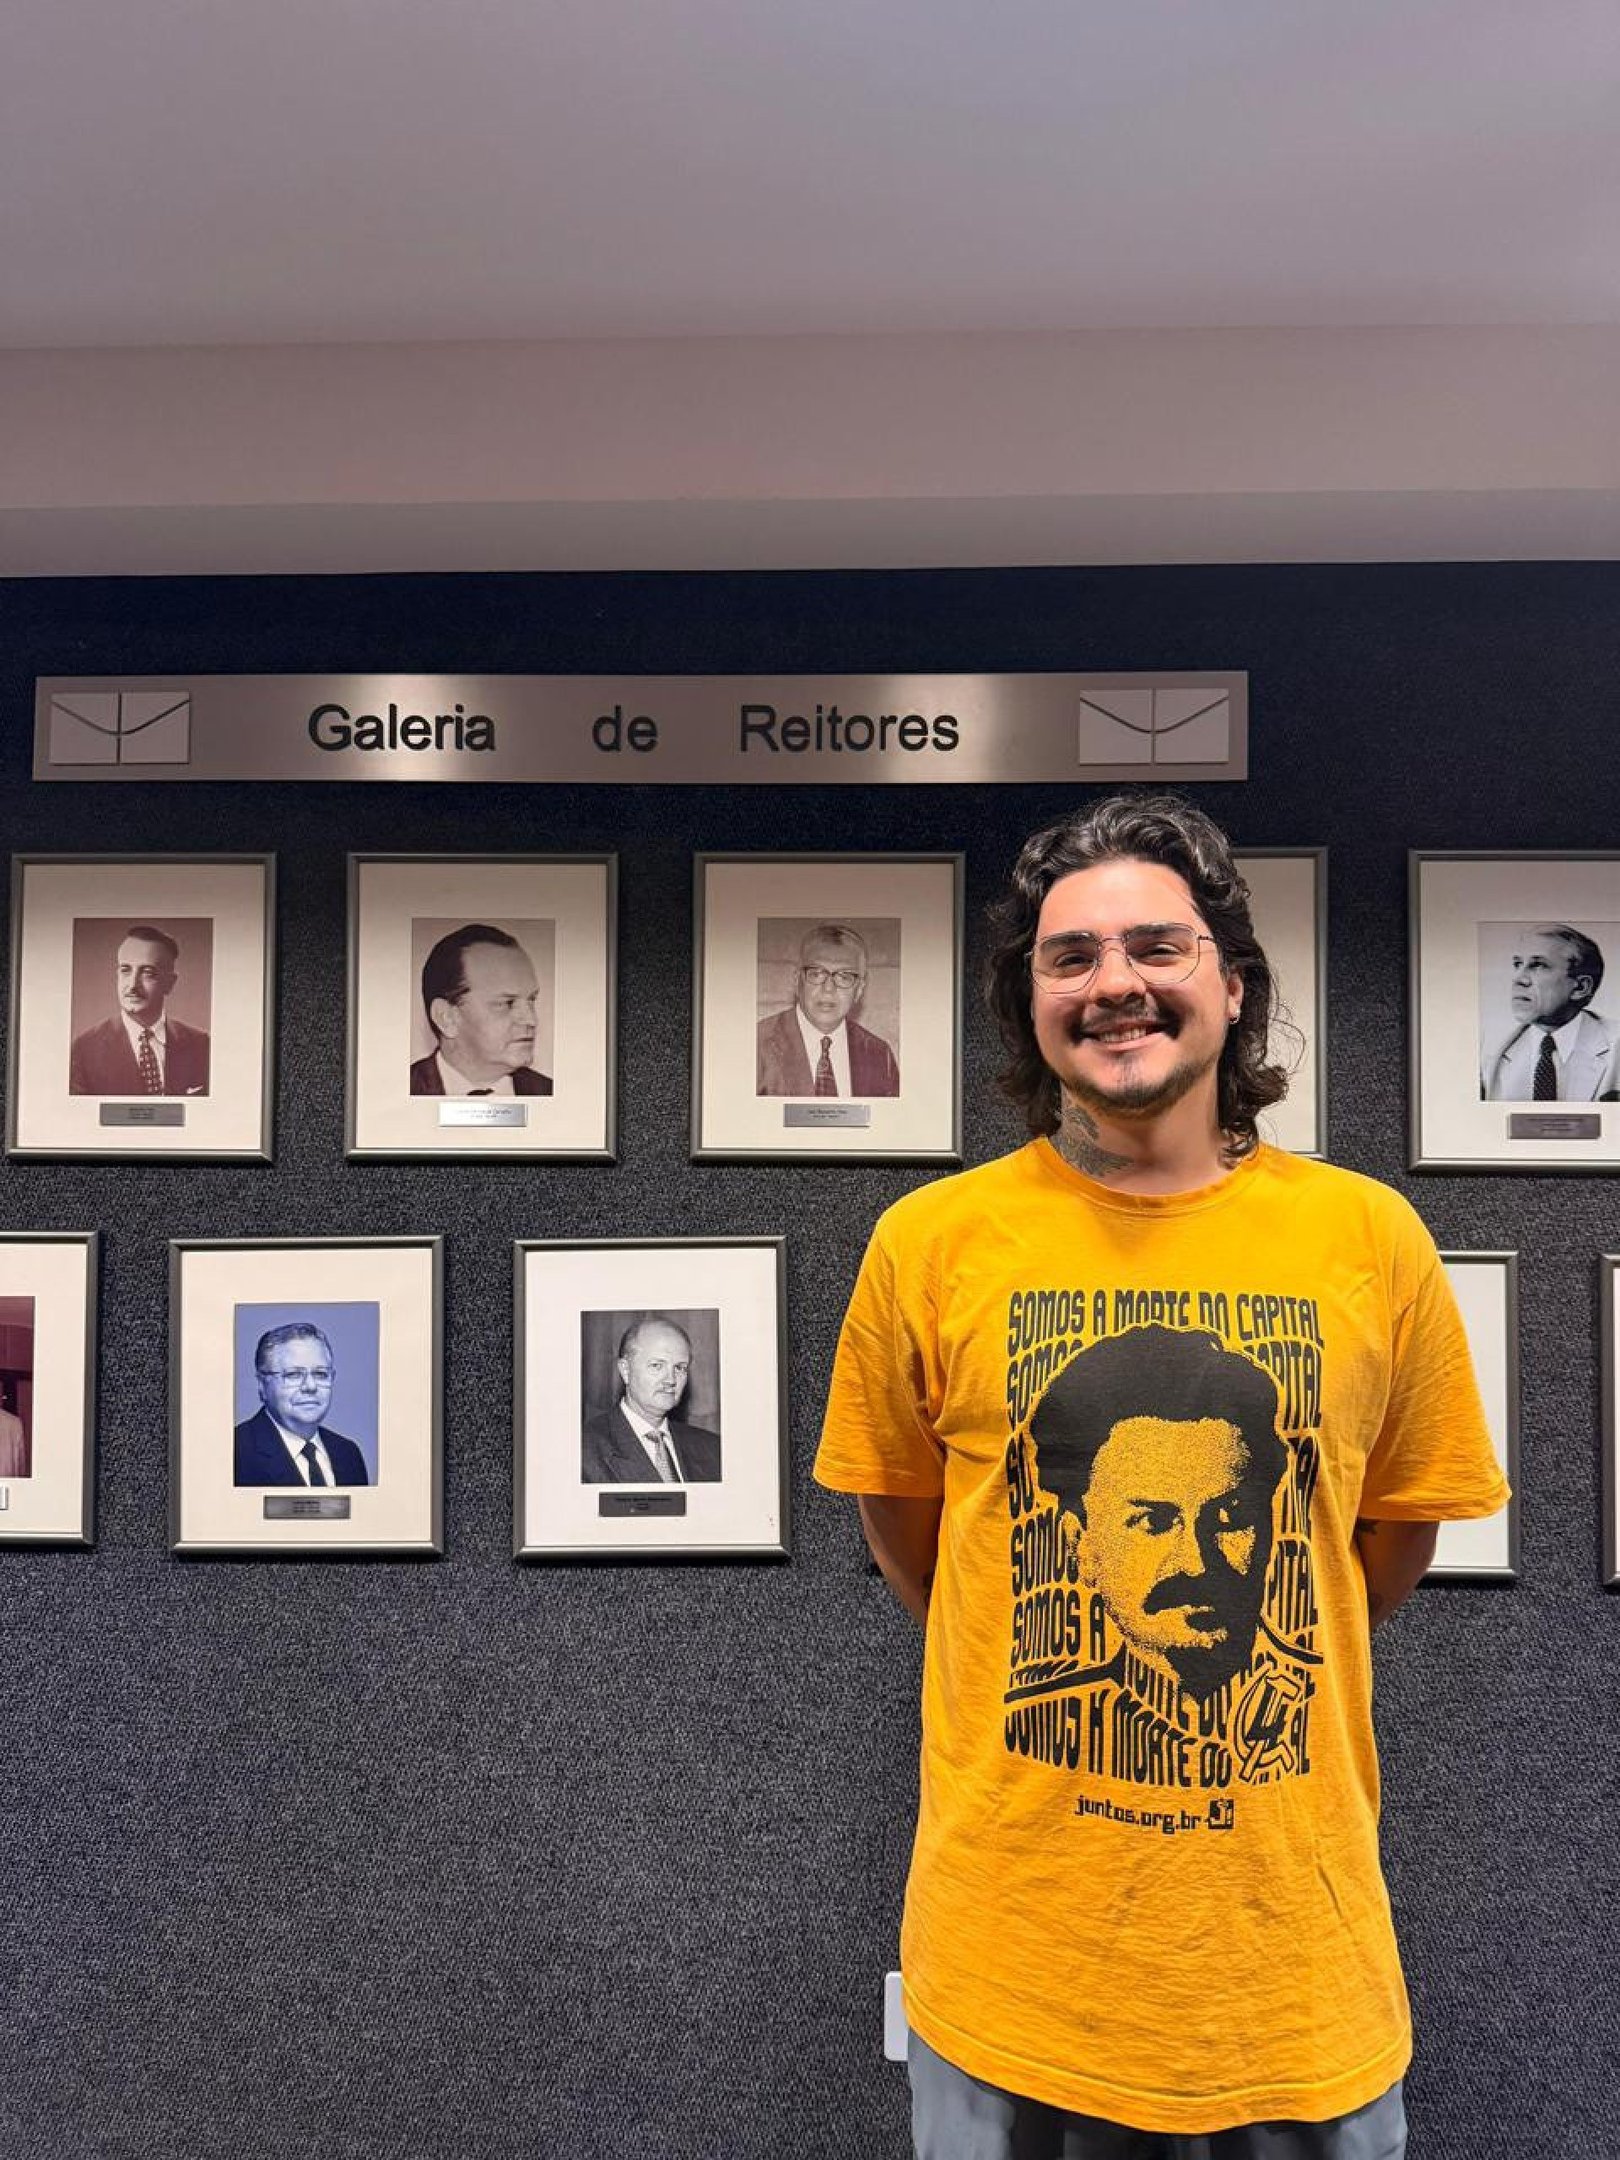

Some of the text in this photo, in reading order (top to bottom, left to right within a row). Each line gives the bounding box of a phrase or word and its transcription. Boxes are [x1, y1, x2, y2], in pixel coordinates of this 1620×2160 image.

[308, 703, 960, 752] Galeria de Reitores
[1007, 1289, 1086, 1358] SOMOS
[1093, 1289, 1107, 1336] A
[1113, 1289, 1191, 1336] MORTE
[1236, 1293, 1325, 1350] CAPITAL
[1006, 1339, 1083, 1432] SOMO
[1010, 1587, 1106, 1669] SOMOS A
[1111, 1689, 1192, 1788] MORTE
[1200, 1742, 1232, 1788] DO
[1075, 1795, 1201, 1835] juntos.org.br
